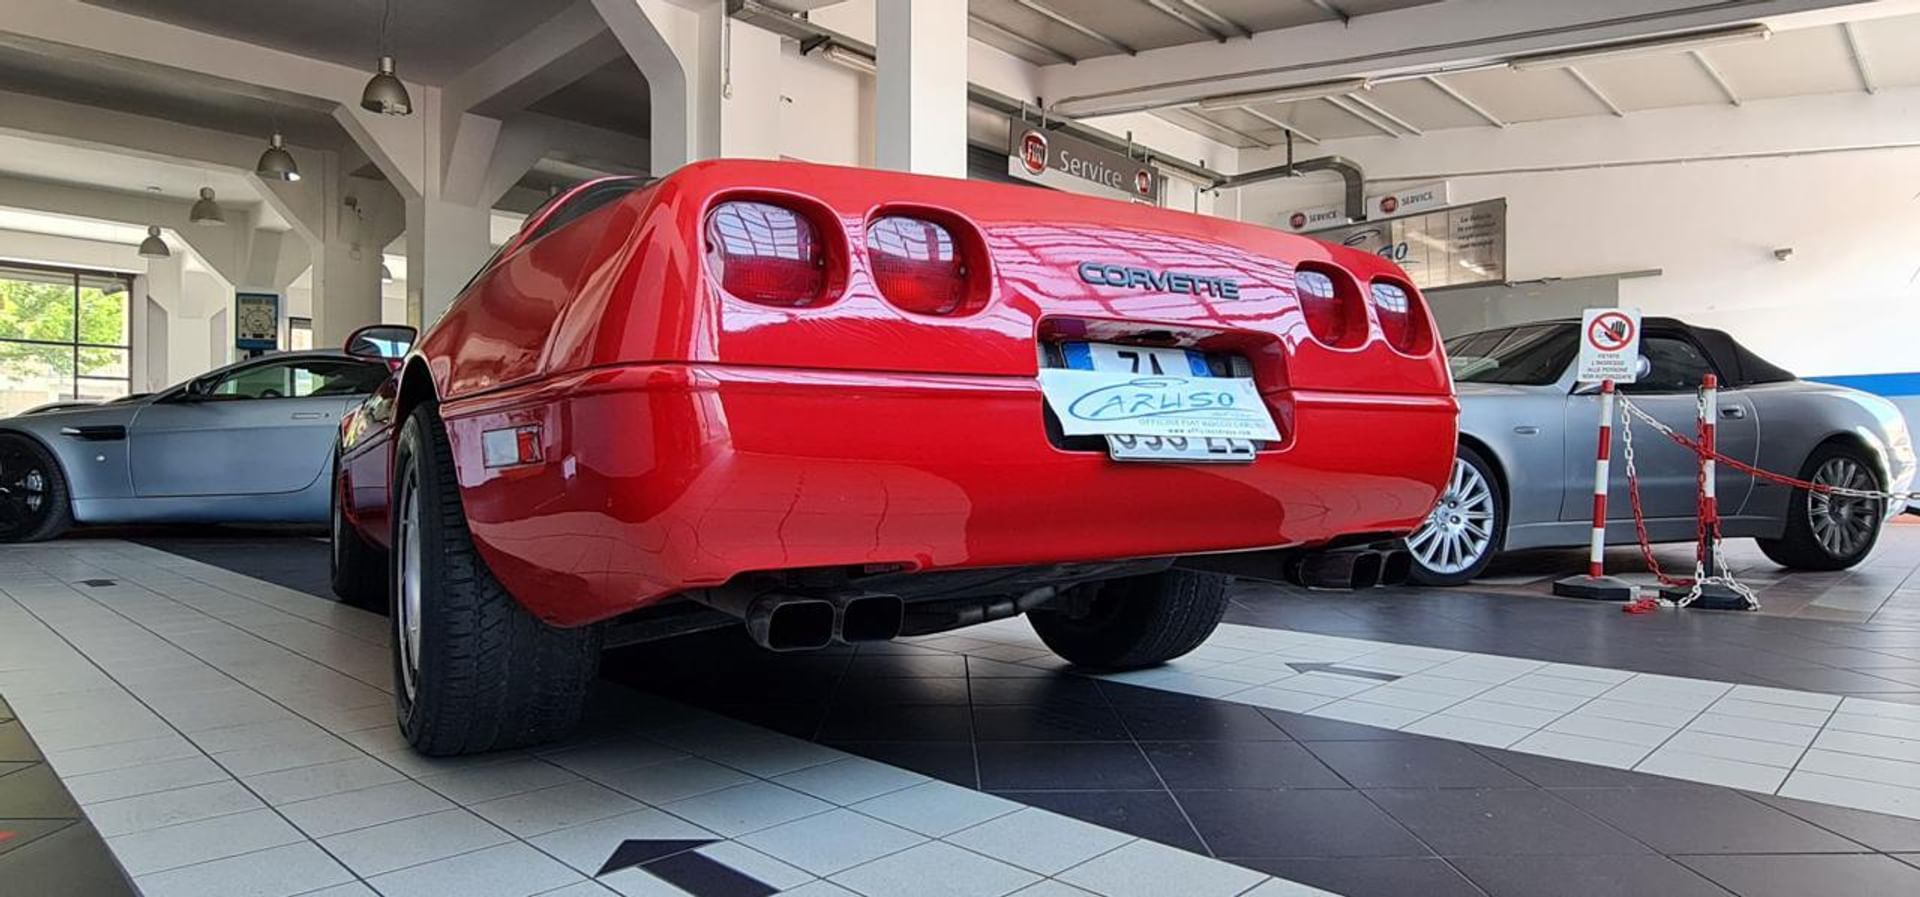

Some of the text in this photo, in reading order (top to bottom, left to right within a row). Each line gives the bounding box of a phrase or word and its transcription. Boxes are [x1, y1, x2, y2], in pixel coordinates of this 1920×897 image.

[1060, 150, 1122, 188] Service
[1309, 211, 1337, 223] SERVICE
[1401, 192, 1433, 206] SERVICE
[1078, 261, 1240, 300] CORVETTE
[1068, 377, 1236, 421] CARUSO
